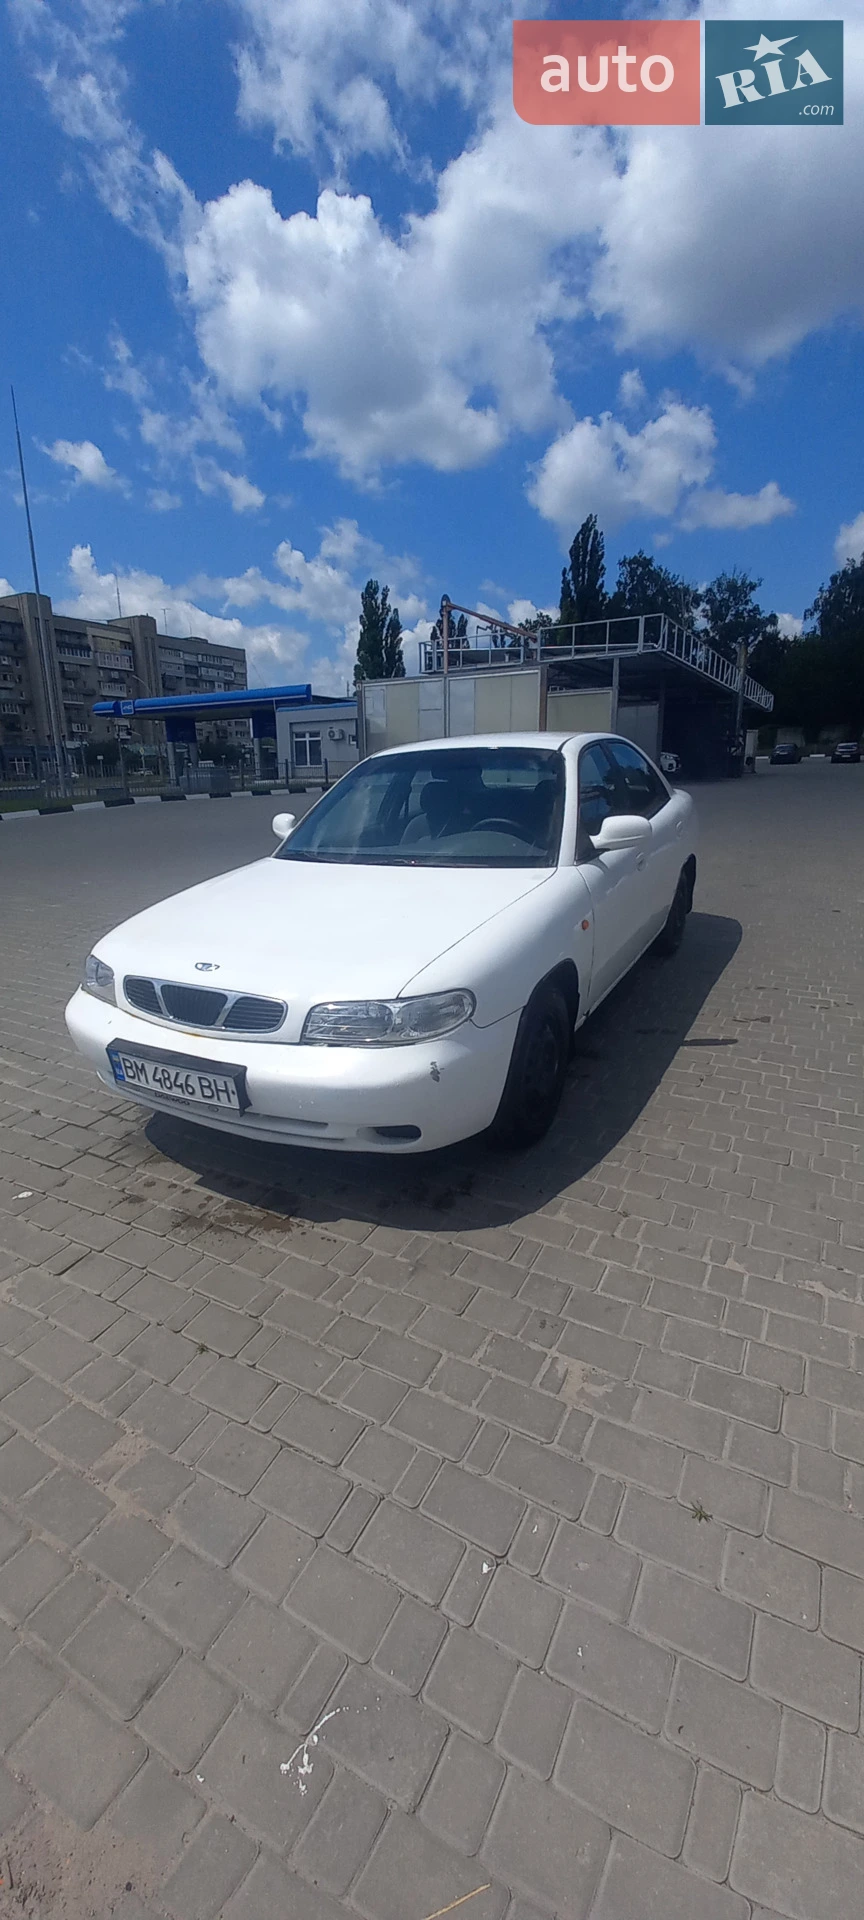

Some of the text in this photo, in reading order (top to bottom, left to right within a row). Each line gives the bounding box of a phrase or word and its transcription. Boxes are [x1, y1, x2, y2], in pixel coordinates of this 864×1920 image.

[121, 1057, 232, 1103] BM 4846 BH
